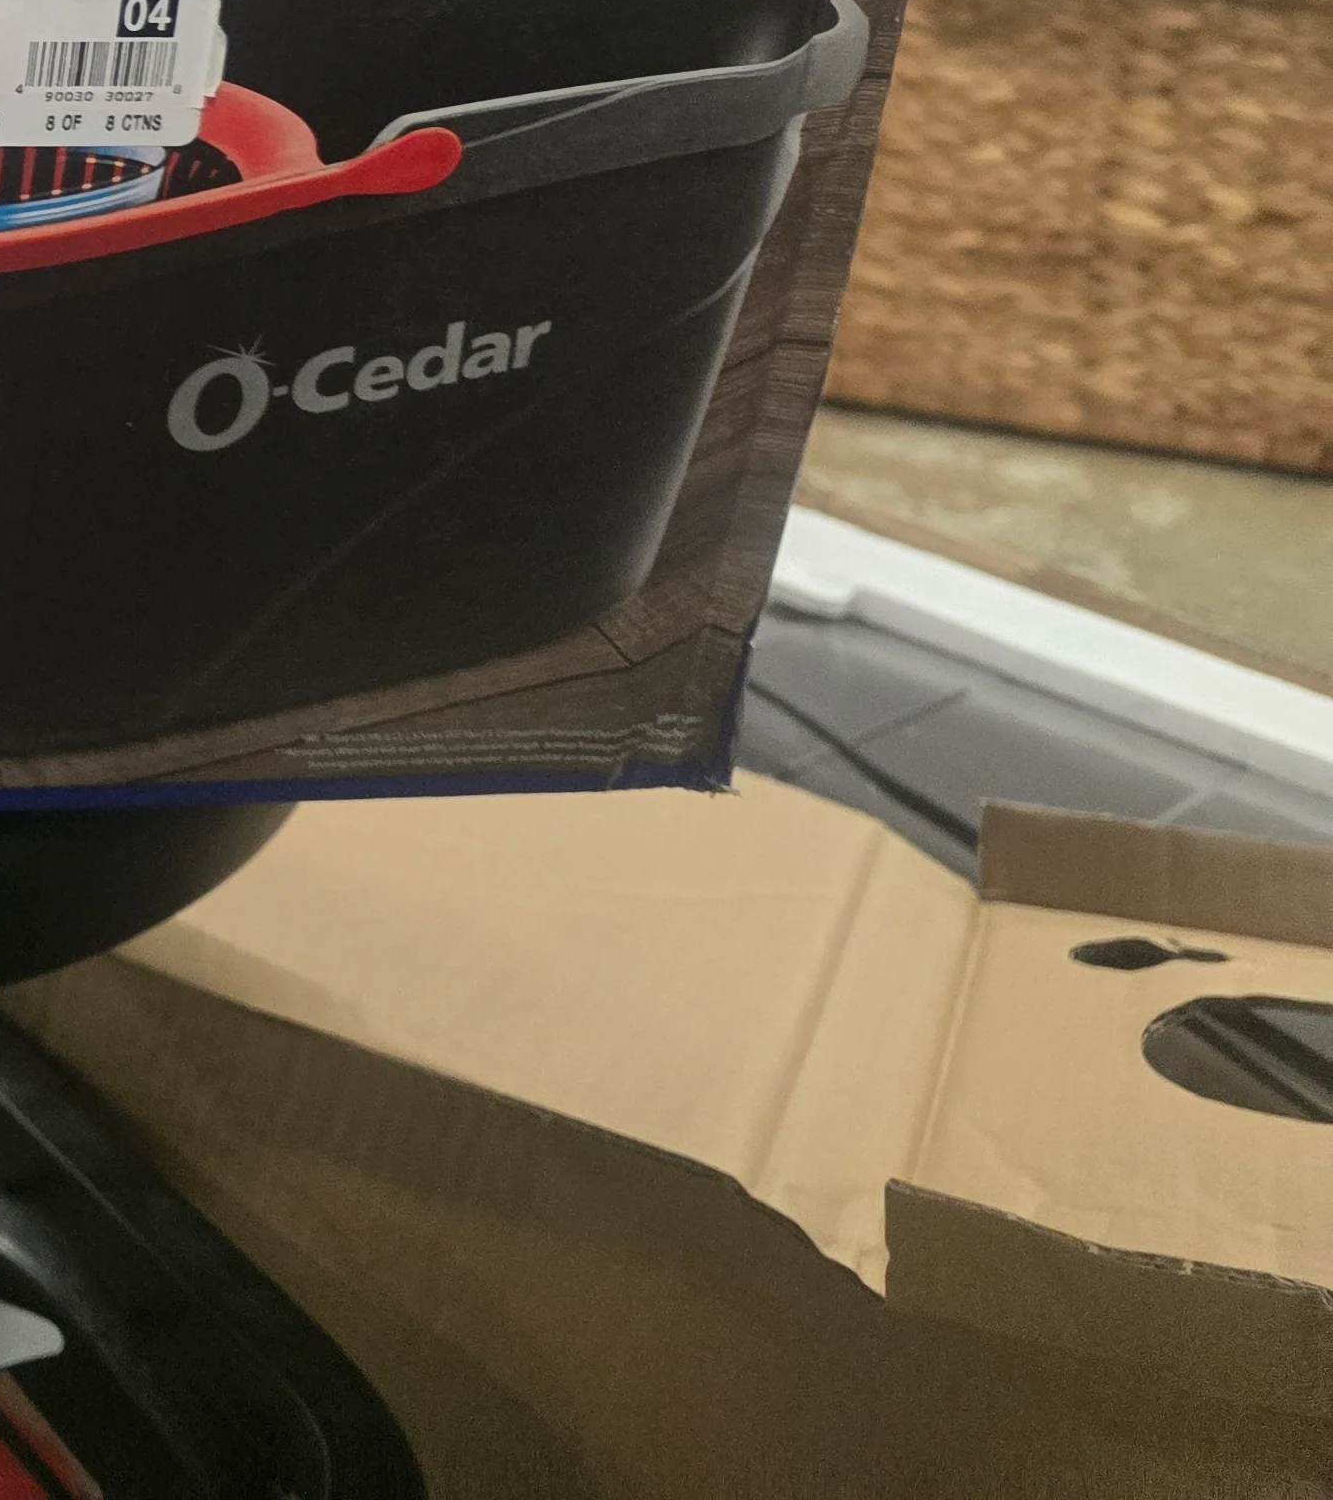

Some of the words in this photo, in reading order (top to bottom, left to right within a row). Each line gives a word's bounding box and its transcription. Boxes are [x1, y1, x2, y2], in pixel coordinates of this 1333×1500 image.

[44, 90, 94, 102] 90030
[104, 90, 154, 102] 30027
[45, 115, 55, 131] 8
[61, 114, 82, 131] OF
[105, 115, 115, 131] 8
[121, 114, 162, 131] CTNS
[167, 320, 552, 452] O-Cedar
